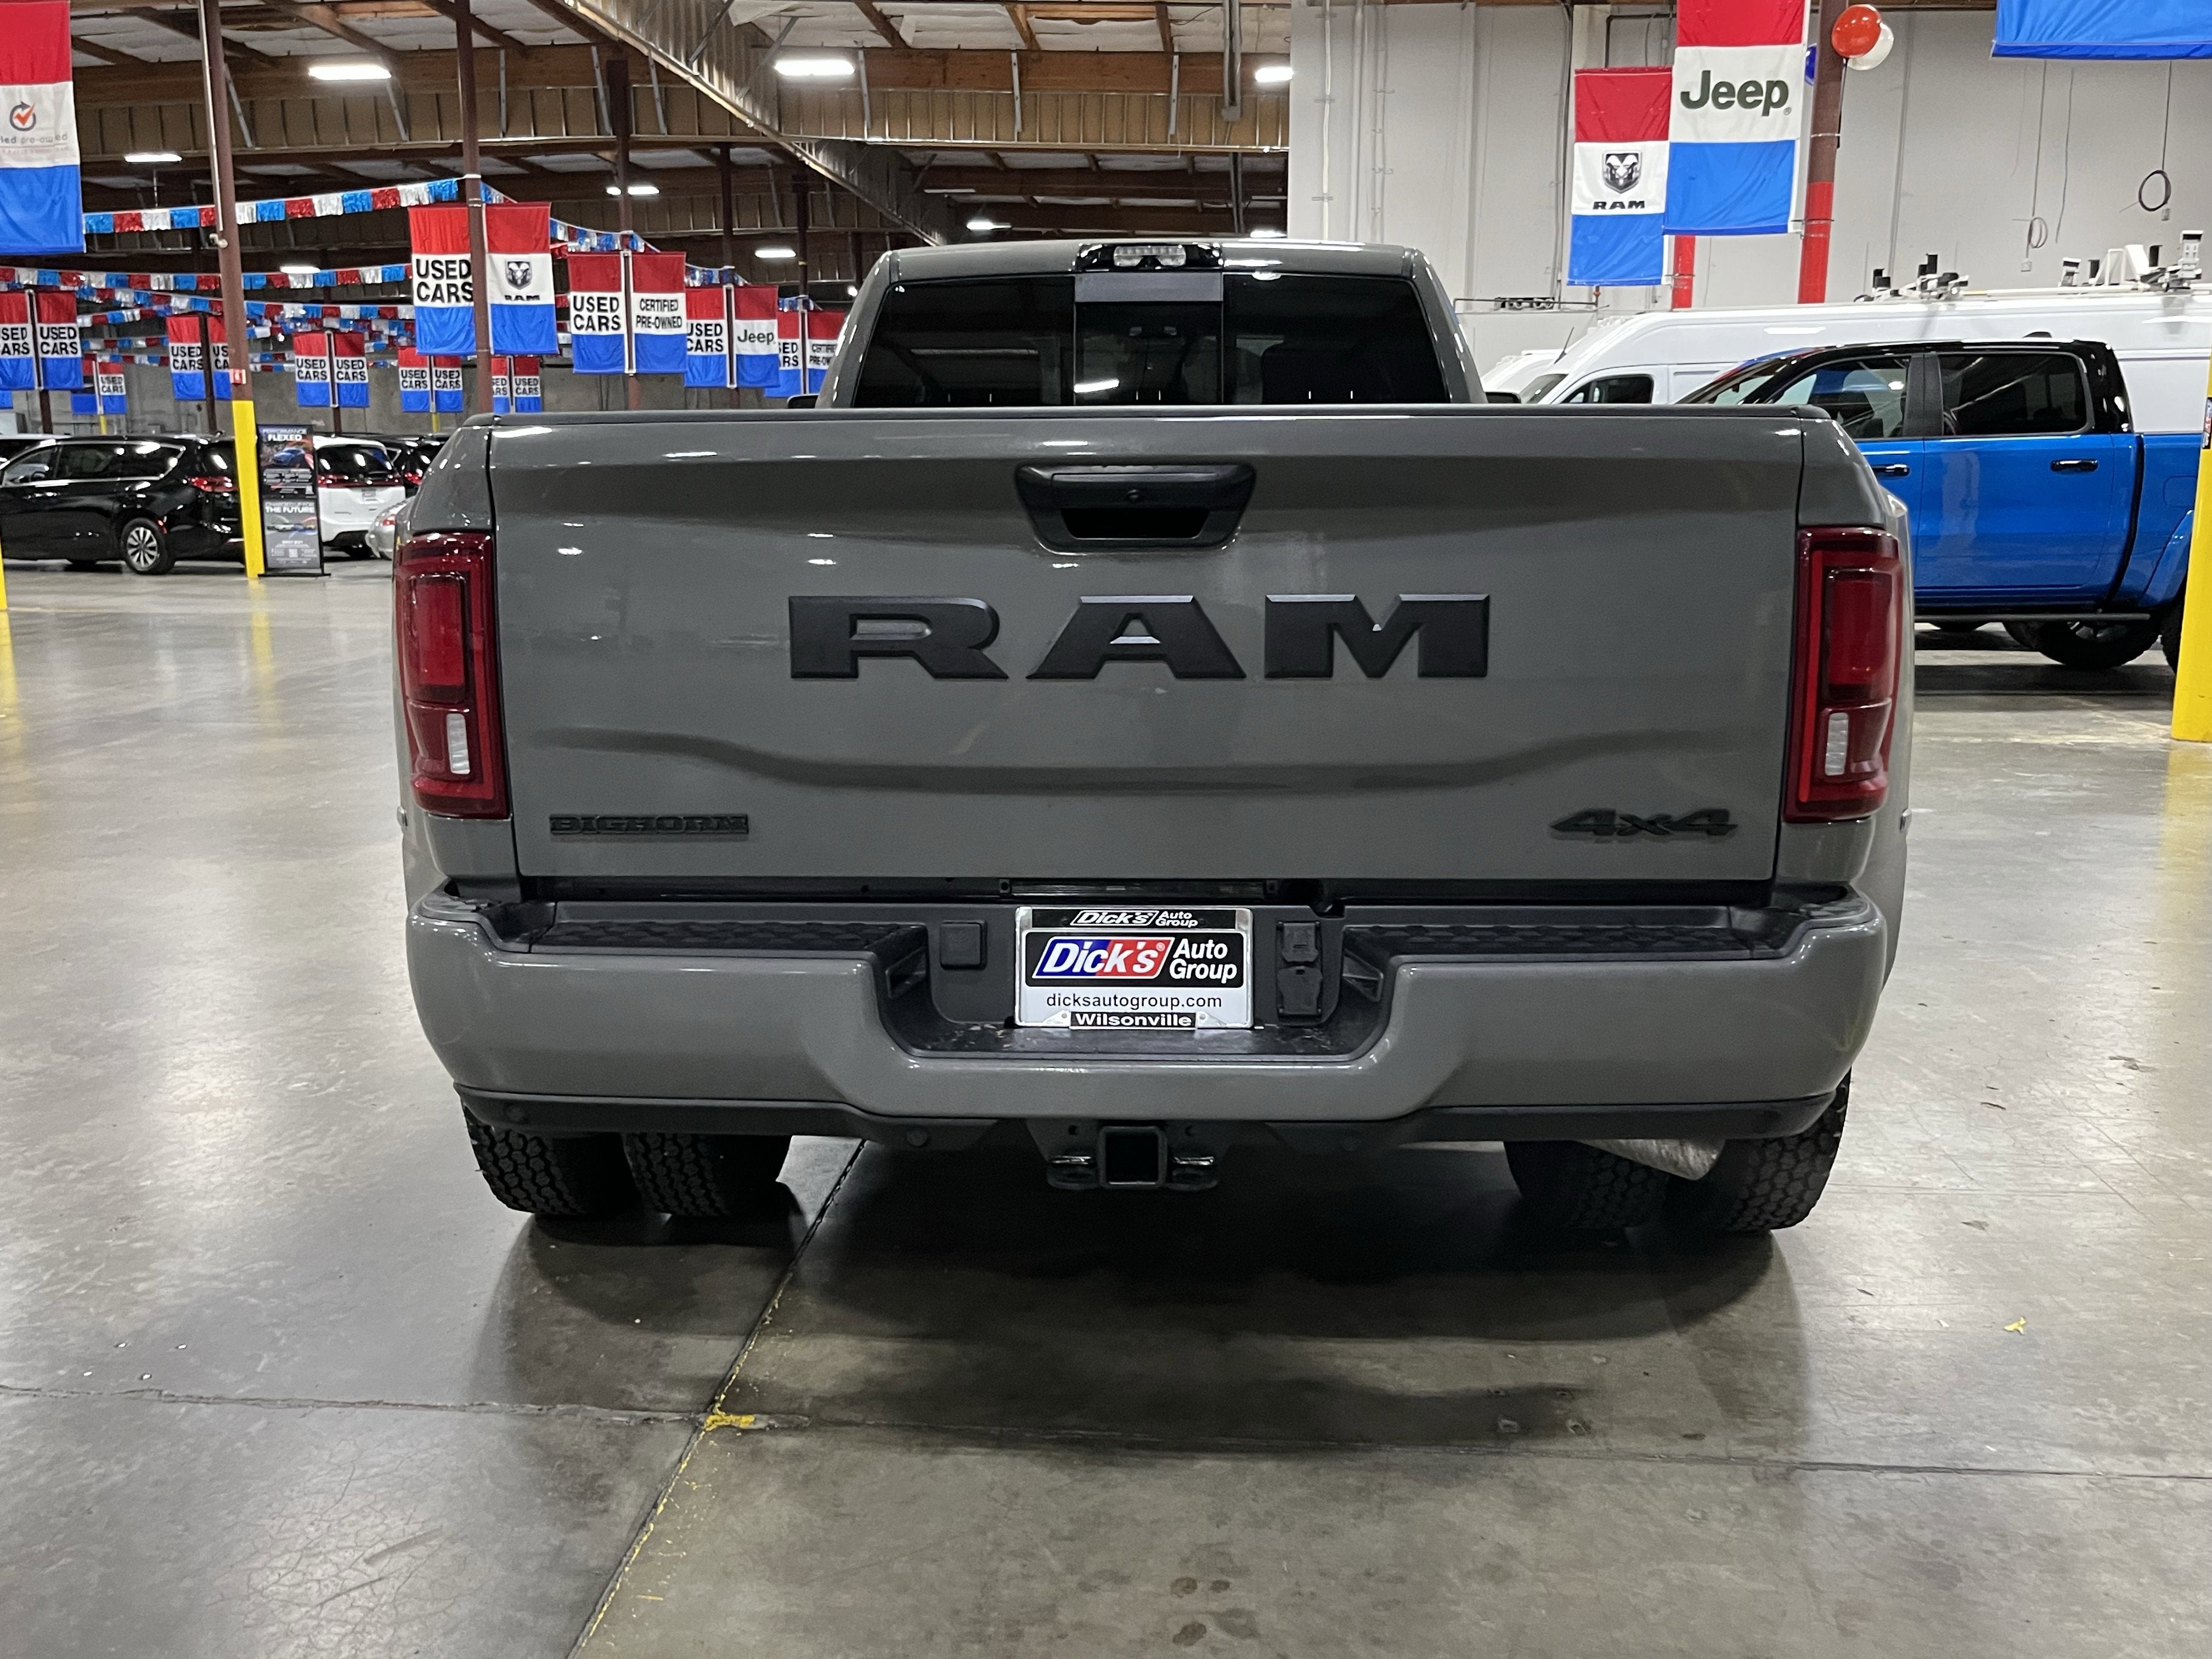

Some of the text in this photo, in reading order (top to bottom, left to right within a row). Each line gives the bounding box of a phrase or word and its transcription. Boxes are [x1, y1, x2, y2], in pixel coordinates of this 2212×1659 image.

[1680, 70, 1790, 117] Jeep
[1593, 200, 1645, 210] RAM
[416, 258, 471, 280] USED
[416, 281, 473, 302] CARS
[573, 295, 619, 313] USED
[640, 298, 679, 312] CERTIFIED
[573, 314, 621, 331] CARS
[636, 315, 682, 329] PRE-OWNED
[1, 327, 27, 340] SED
[40, 326, 77, 340] USED
[737, 329, 774, 345] Jeep
[1, 342, 30, 355] ARS
[40, 342, 78, 355] CARS
[171, 346, 202, 357] USED
[213, 346, 228, 357] US
[687, 338, 724, 352] CARS
[173, 359, 204, 370] CARS
[215, 359, 229, 370] CA
[296, 358, 326, 369] USED
[336, 359, 364, 369] USED
[779, 355, 798, 367] RS
[101, 376, 123, 385] USED
[297, 370, 328, 380] CARS
[336, 370, 366, 381] CARS
[401, 370, 427, 379] USED
[435, 369, 460, 379] USED
[402, 380, 427, 389] CARS
[435, 379, 461, 389] CARS
[516, 387, 539, 395] CARS
[789, 594, 1490, 681] RAM
[1550, 808, 1739, 836] 4x4
[1077, 911, 1193, 924] Dick's Auto
[1155, 918, 1199, 928] Group
[1043, 938, 1228, 973] Dick's Auto
[1169, 958, 1238, 984] Group
[1046, 992, 1222, 1010] dicksautogroup.com
[1075, 1013, 1193, 1027] Wilsonville
